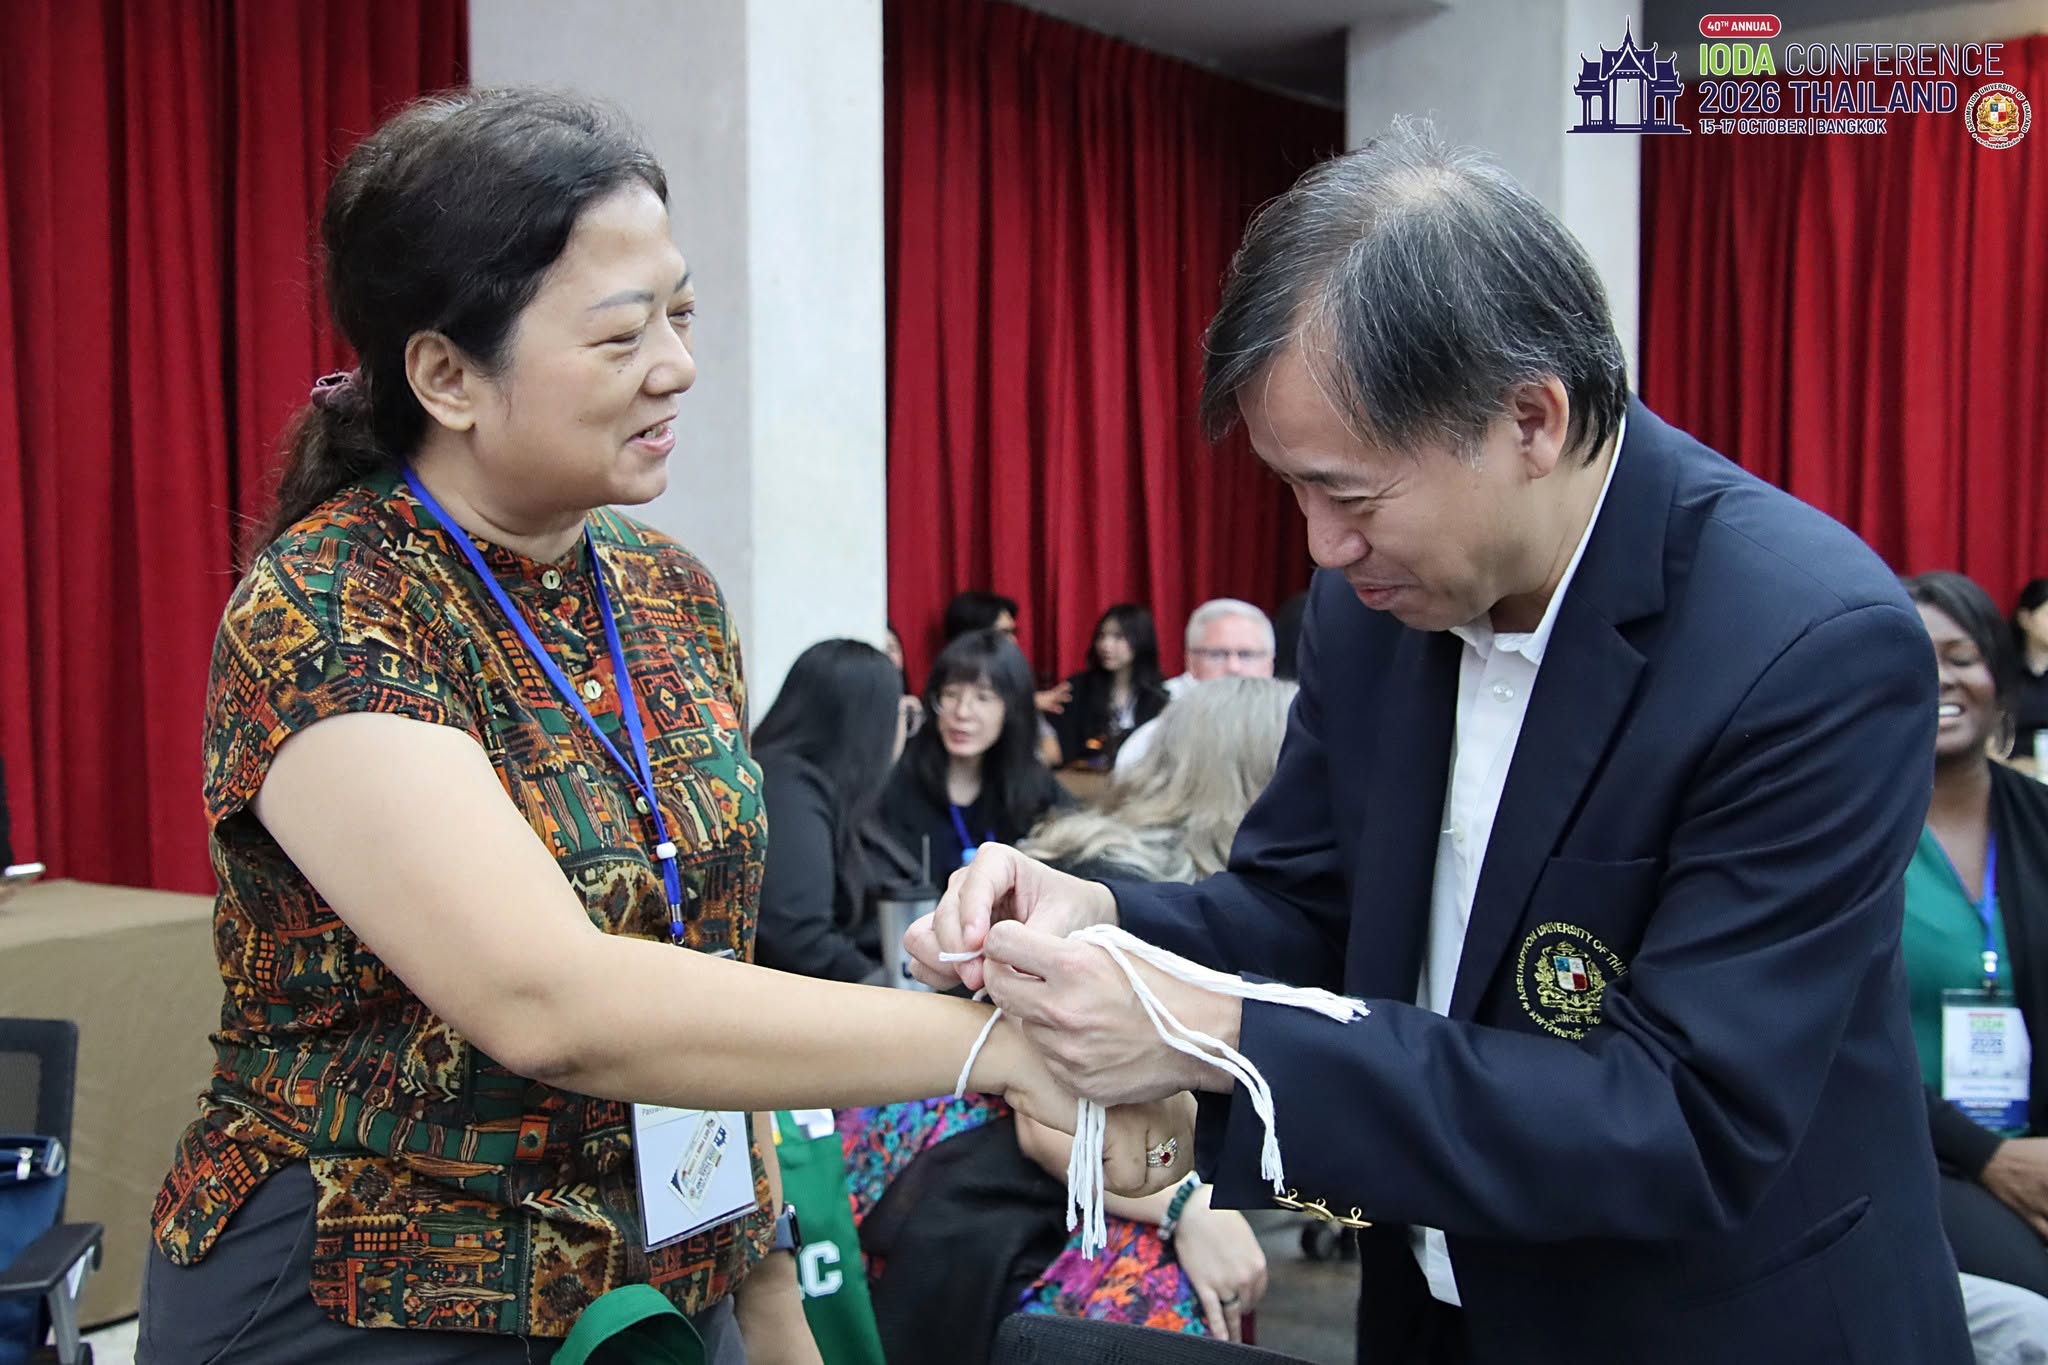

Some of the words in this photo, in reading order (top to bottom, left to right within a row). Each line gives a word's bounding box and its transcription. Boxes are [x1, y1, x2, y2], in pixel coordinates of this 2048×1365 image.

[1517, 931, 1538, 1000] ASSUMPTION
[1536, 922, 1593, 943] UNIVERSITY
[1593, 940, 1610, 954] OF
[1555, 1014, 1582, 1023] SINCE
[1584, 1015, 1601, 1025] 196
